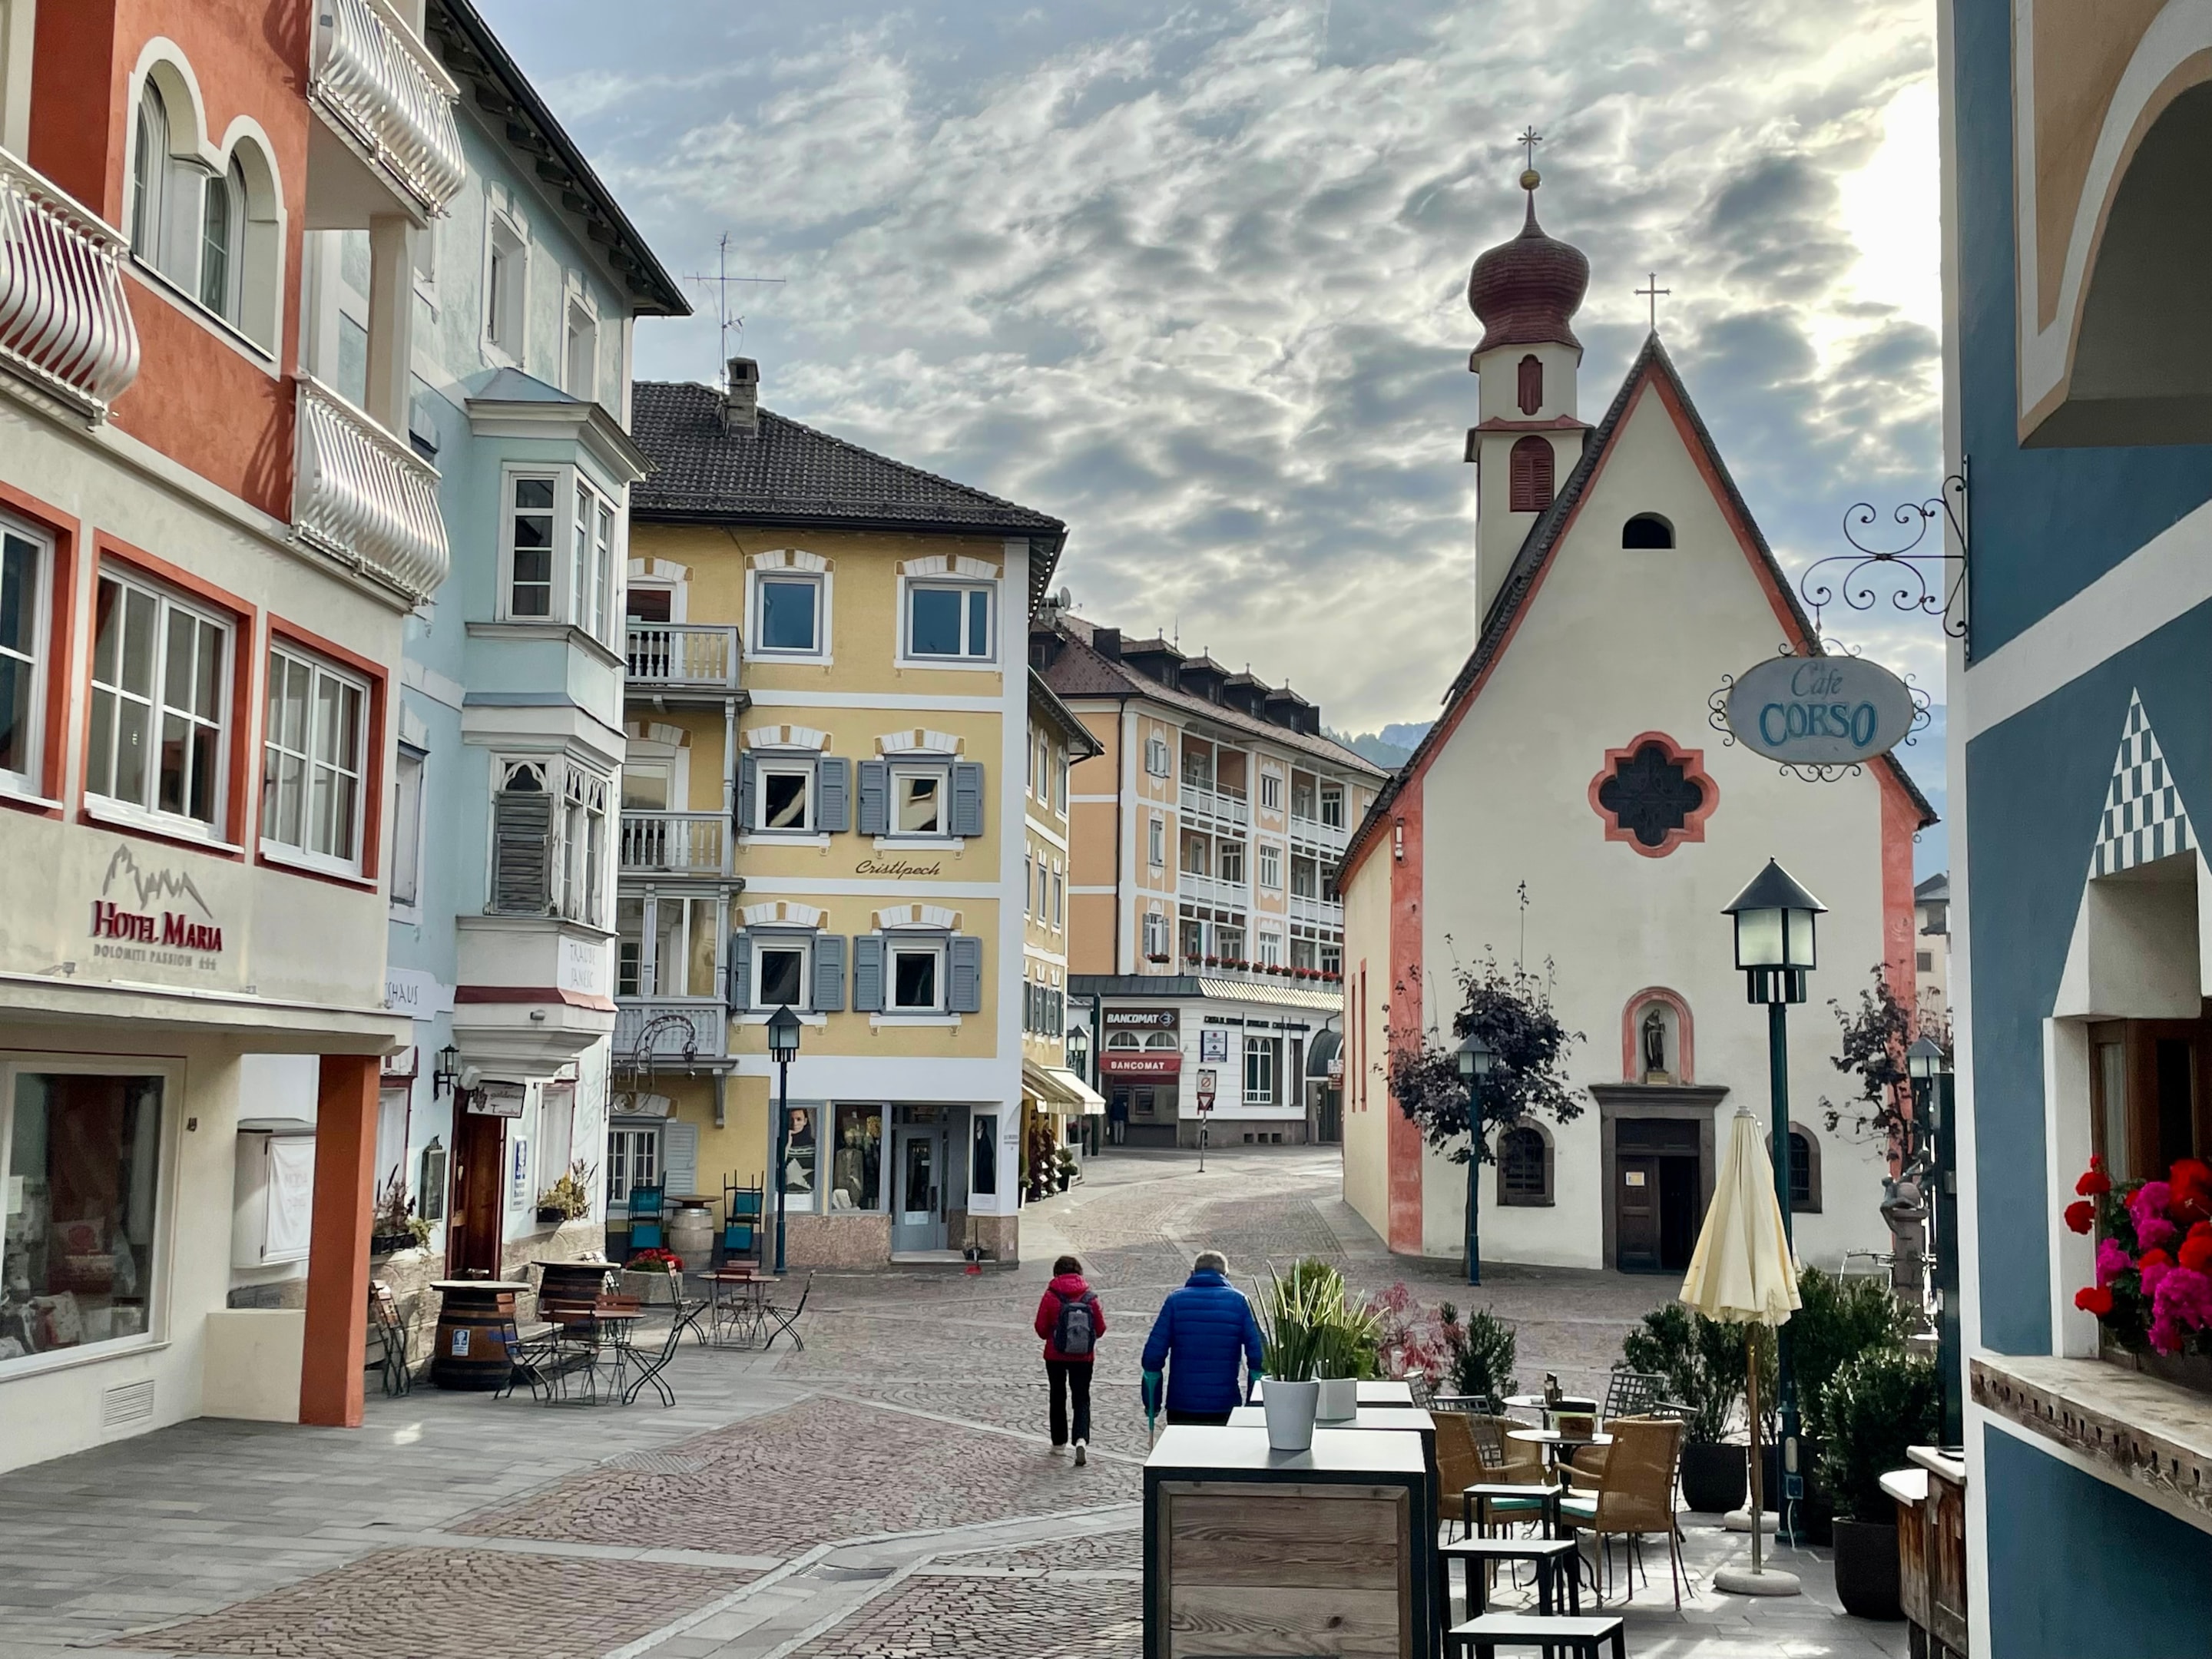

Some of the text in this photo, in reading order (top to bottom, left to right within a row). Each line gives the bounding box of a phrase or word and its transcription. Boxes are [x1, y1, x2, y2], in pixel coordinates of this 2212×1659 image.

[1758, 700, 1877, 749] CORSO
[855, 859, 941, 880] Cristlpech
[93, 943, 193, 968] DOLOMITI PASSION
[1106, 1013, 1160, 1024] BANCOMAT
[1110, 1061, 1165, 1071] BANCOMAT
